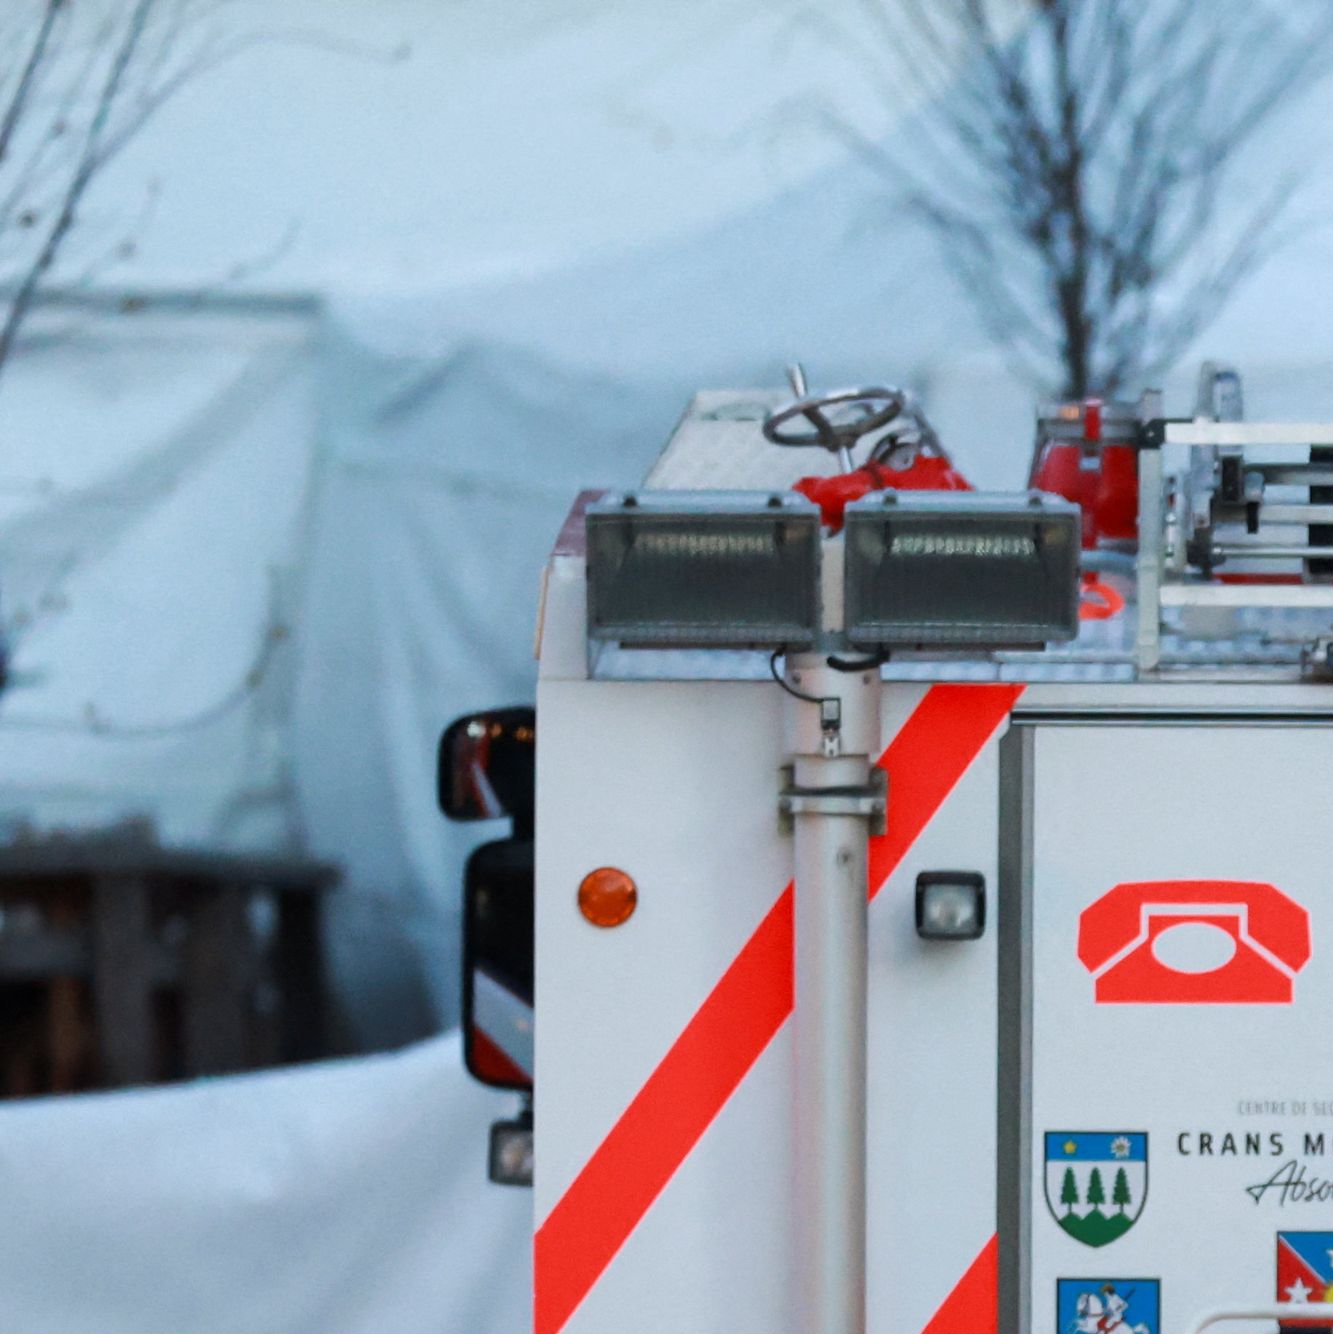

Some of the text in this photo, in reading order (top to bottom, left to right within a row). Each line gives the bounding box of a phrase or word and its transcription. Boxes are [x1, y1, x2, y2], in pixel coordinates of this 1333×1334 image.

[1237, 1102, 1286, 1117] CENTRE
[1290, 1102, 1308, 1117] DE
[1178, 1132, 1284, 1156] CRANS
